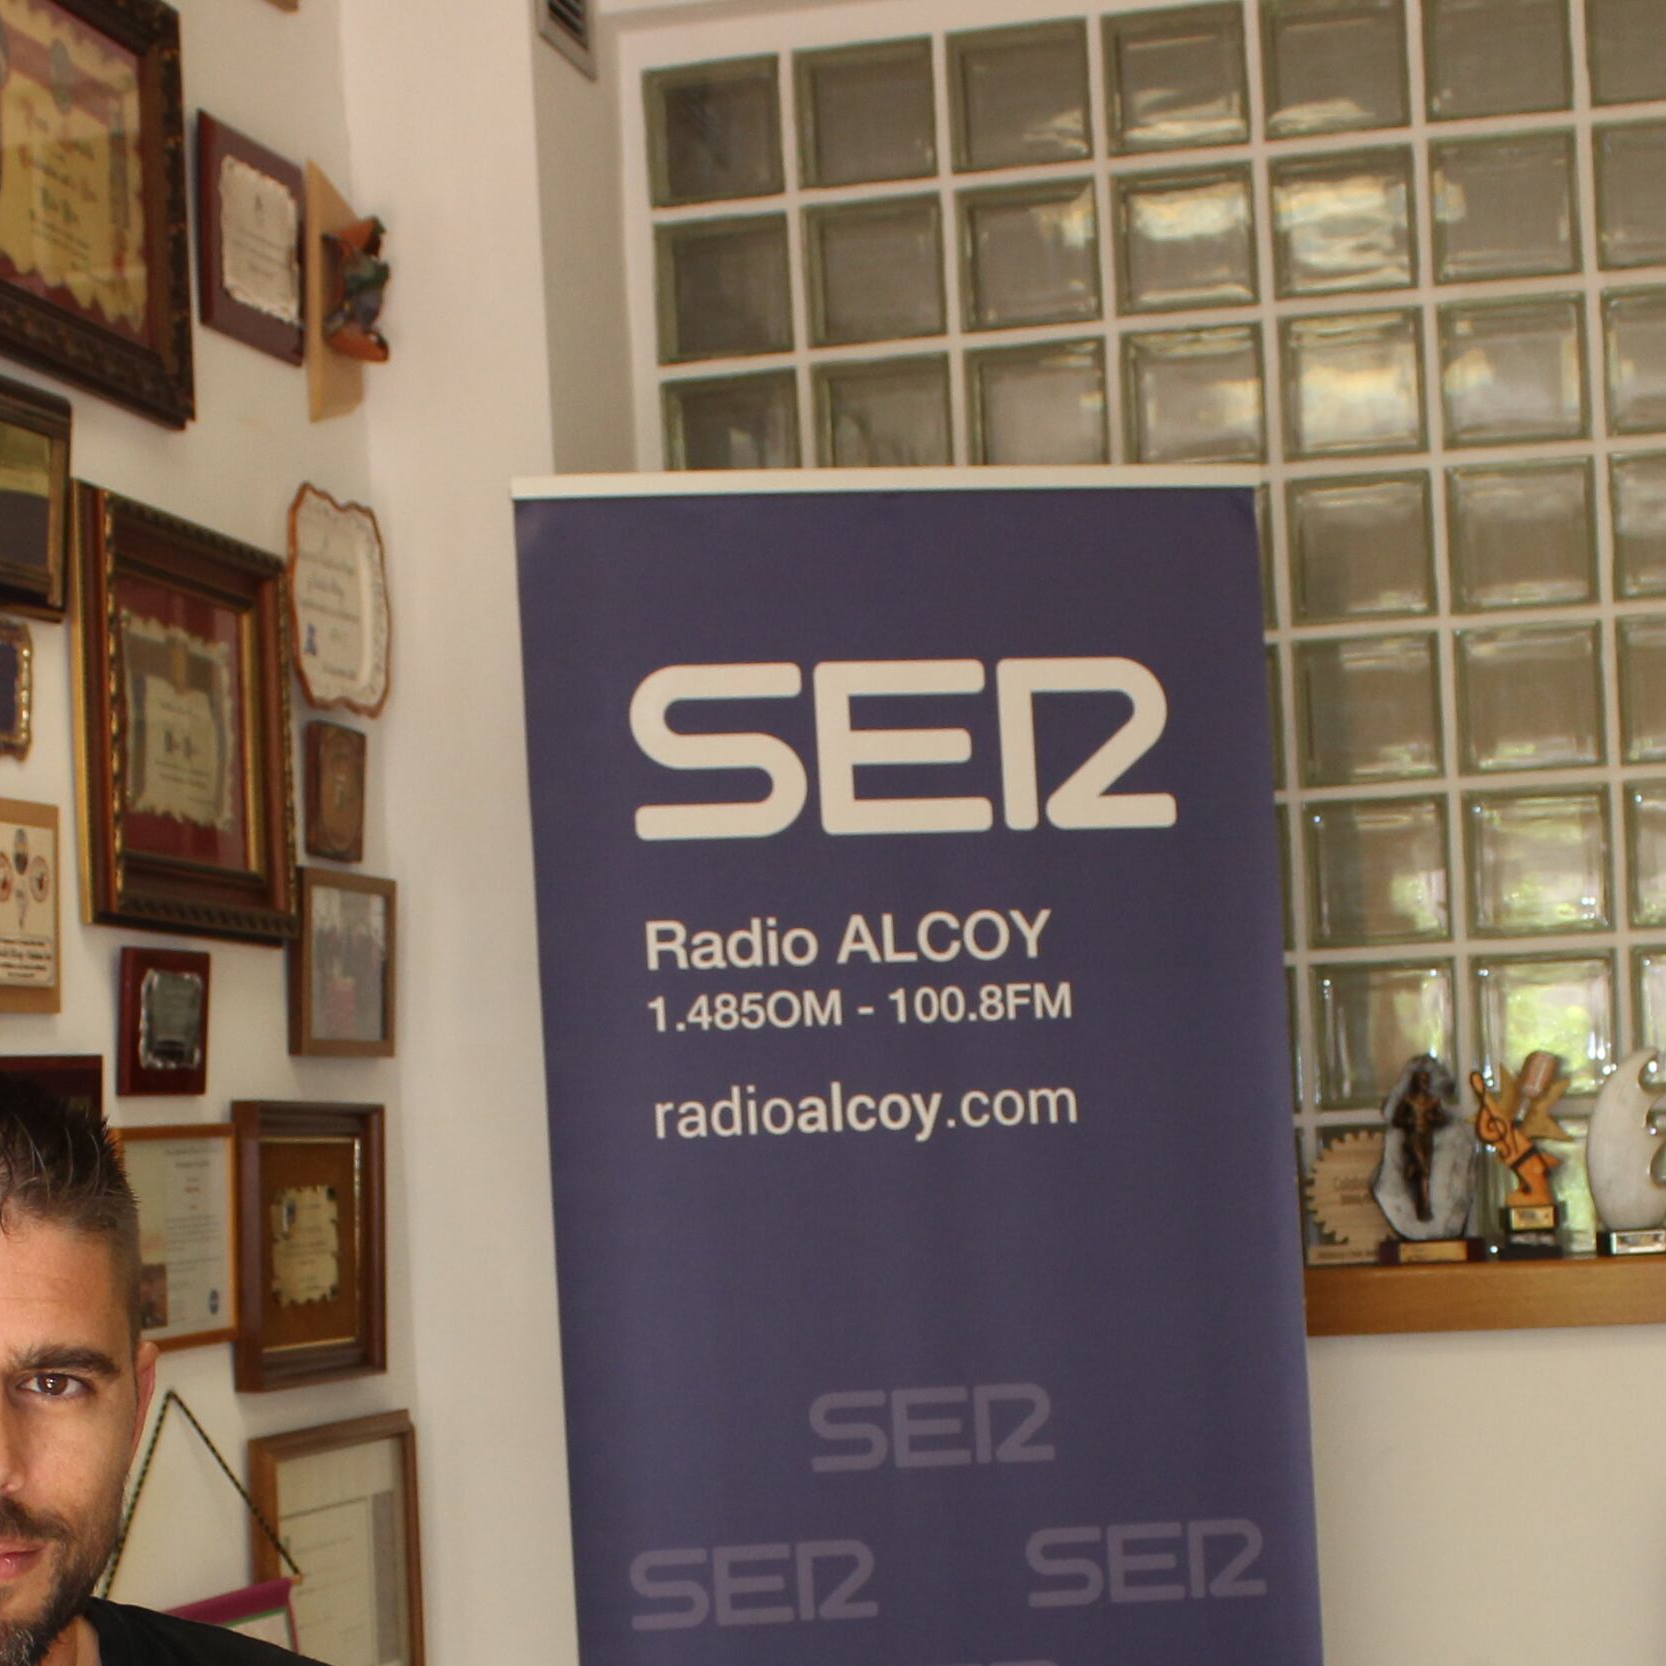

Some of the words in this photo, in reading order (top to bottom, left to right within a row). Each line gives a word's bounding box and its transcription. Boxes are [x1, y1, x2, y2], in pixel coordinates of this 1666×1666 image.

[629, 655, 1178, 841] SER
[644, 917, 820, 973] Radio
[836, 908, 1053, 967] ALCOY
[887, 981, 1074, 1025] 100.8FM
[654, 1080, 1079, 1144] radioalcoy.com
[808, 1382, 1055, 1474] SER
[629, 1539, 879, 1632] SER
[1026, 1518, 1268, 1608] SER
